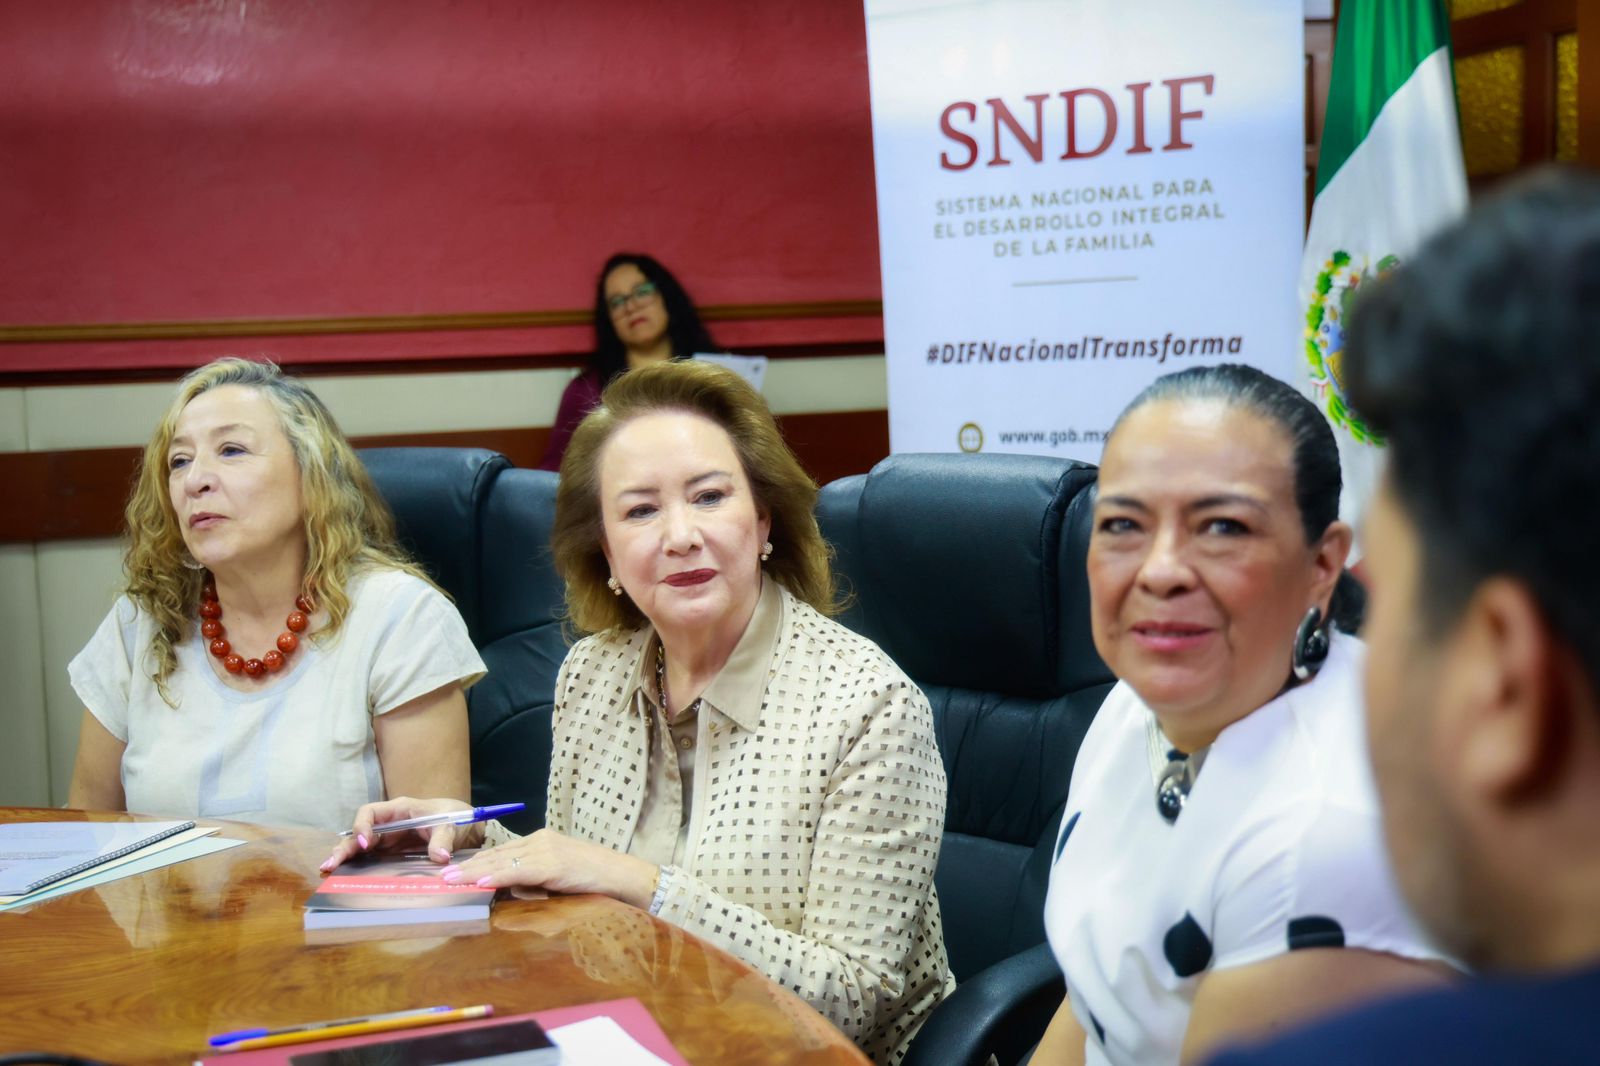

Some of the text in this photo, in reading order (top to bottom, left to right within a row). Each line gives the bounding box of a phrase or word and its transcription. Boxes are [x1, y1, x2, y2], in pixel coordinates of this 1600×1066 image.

[938, 74, 1214, 172] SNDIF
[935, 178, 1214, 216] SISTEMA NACIONAL PARA
[934, 202, 1225, 239] EL DESARROLLO INTEGRAL
[993, 231, 1155, 258] DE LA FAMILIA
[926, 333, 1243, 365] #DIFNacionalTransforma
